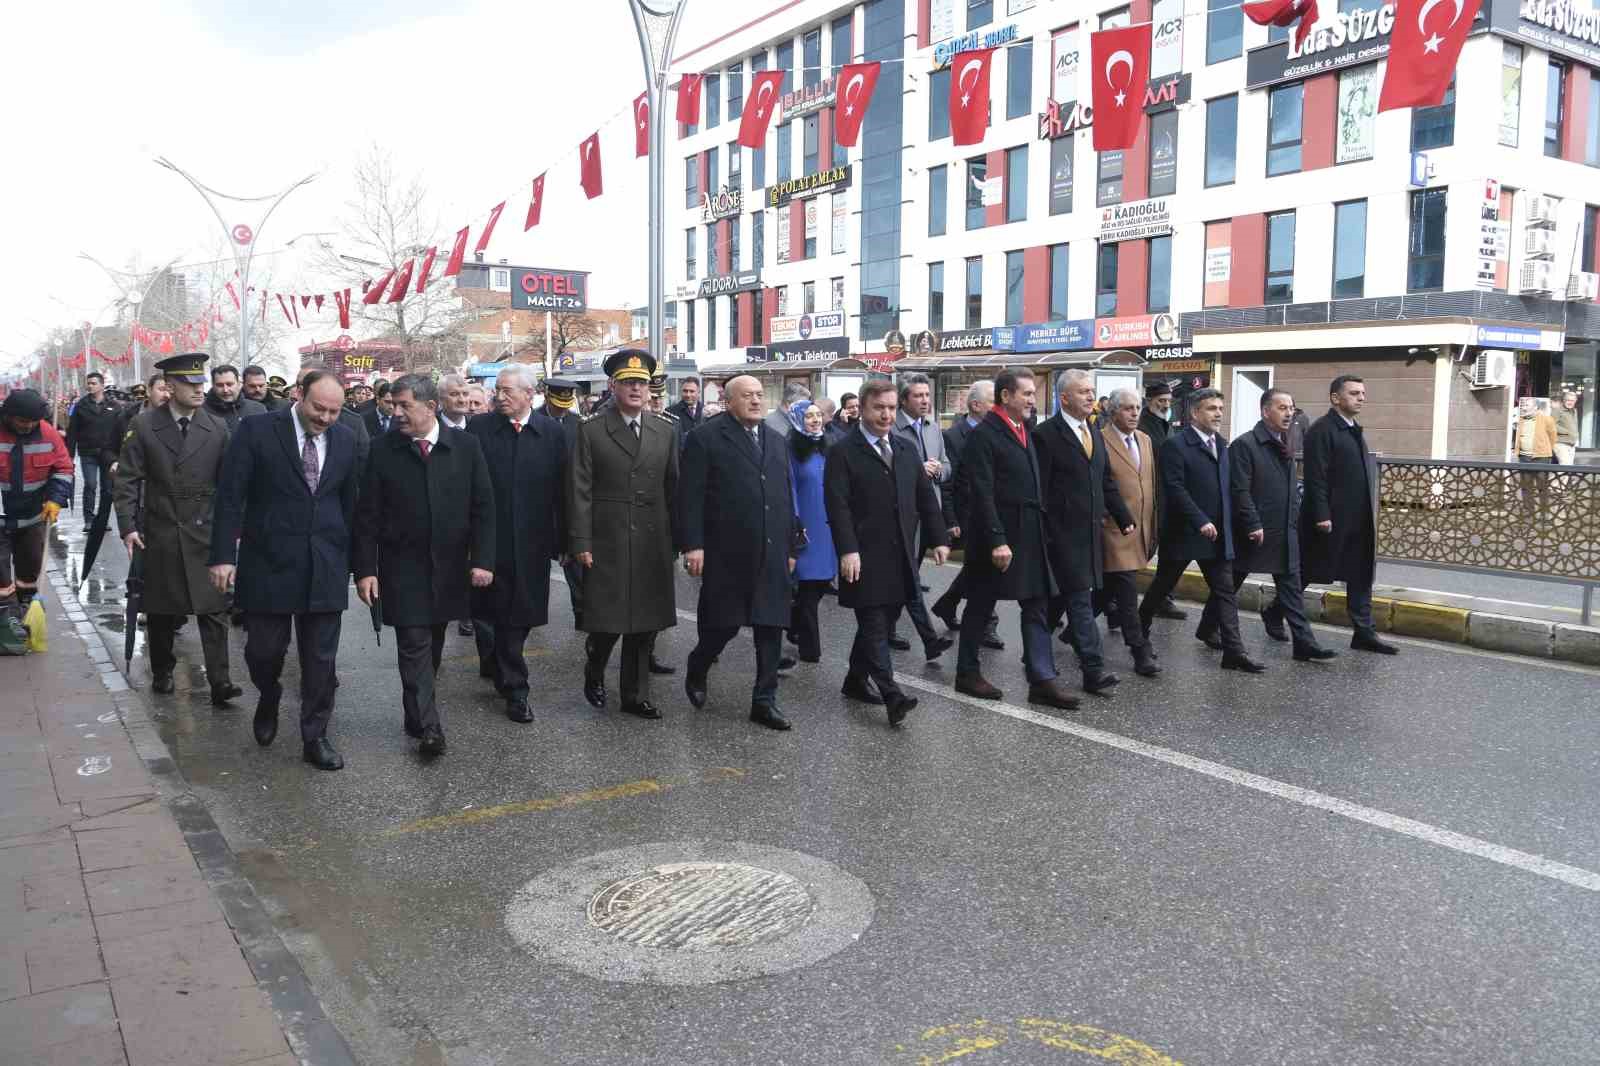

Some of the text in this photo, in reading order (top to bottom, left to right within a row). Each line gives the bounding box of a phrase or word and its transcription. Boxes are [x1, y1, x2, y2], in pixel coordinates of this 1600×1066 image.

[1154, 18, 1183, 40] ACR
[1331, 3, 1396, 48] SÜZG
[1063, 101, 1094, 131] AC
[780, 177, 809, 195] POLAT
[812, 167, 846, 187] EMLAK
[1114, 200, 1166, 220] KADIOĞLU
[1116, 227, 1146, 238] KADIOĞLU
[1147, 223, 1170, 233] TAYFUR
[521, 272, 578, 295] OTEL
[712, 275, 738, 292] DORA
[1030, 326, 1080, 339] MERKEZ BÜFE
[1114, 321, 1151, 331] TURKISH
[1114, 331, 1150, 341] AIRLINES
[785, 349, 838, 361] Türk Telekom
[1145, 347, 1193, 359] PEGASUS
[344, 354, 375, 368] Safir
[1161, 361, 1202, 370] PEGASUS
